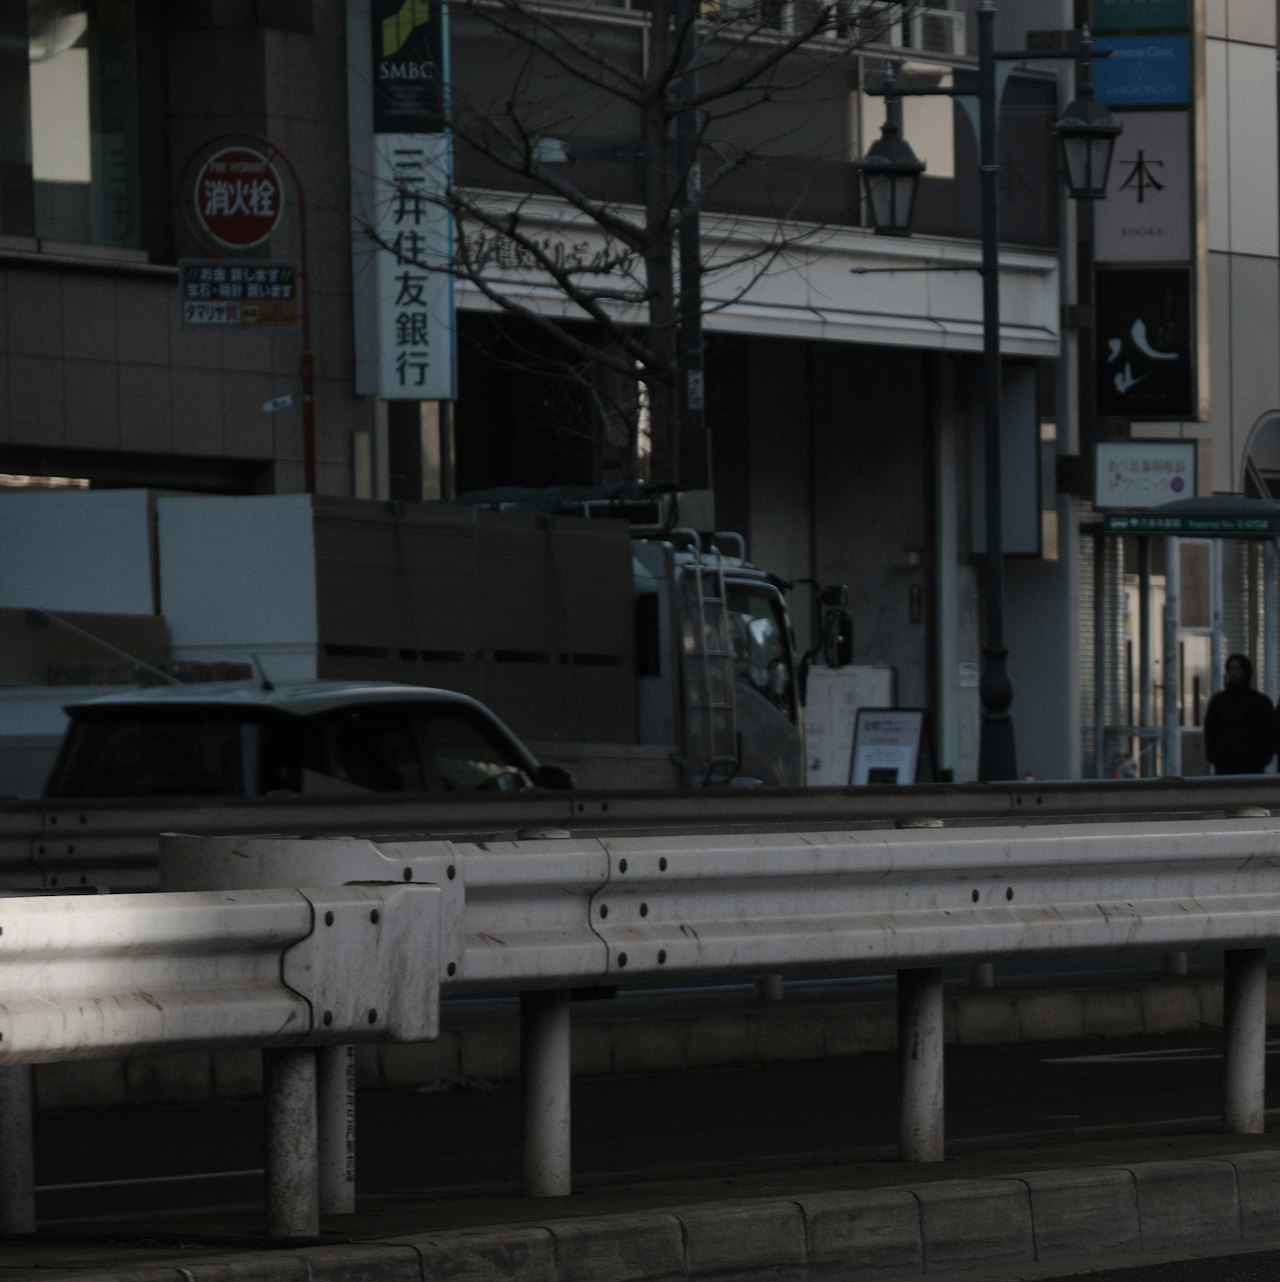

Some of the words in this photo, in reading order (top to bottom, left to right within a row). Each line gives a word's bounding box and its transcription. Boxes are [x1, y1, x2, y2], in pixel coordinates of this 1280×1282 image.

[379, 61, 436, 78] SMBC
[1118, 149, 1166, 203] 本
[205, 178, 275, 217] 消火栓
[1121, 227, 1163, 237] BOOKS
[392, 149, 430, 386] 三井住友銀行
